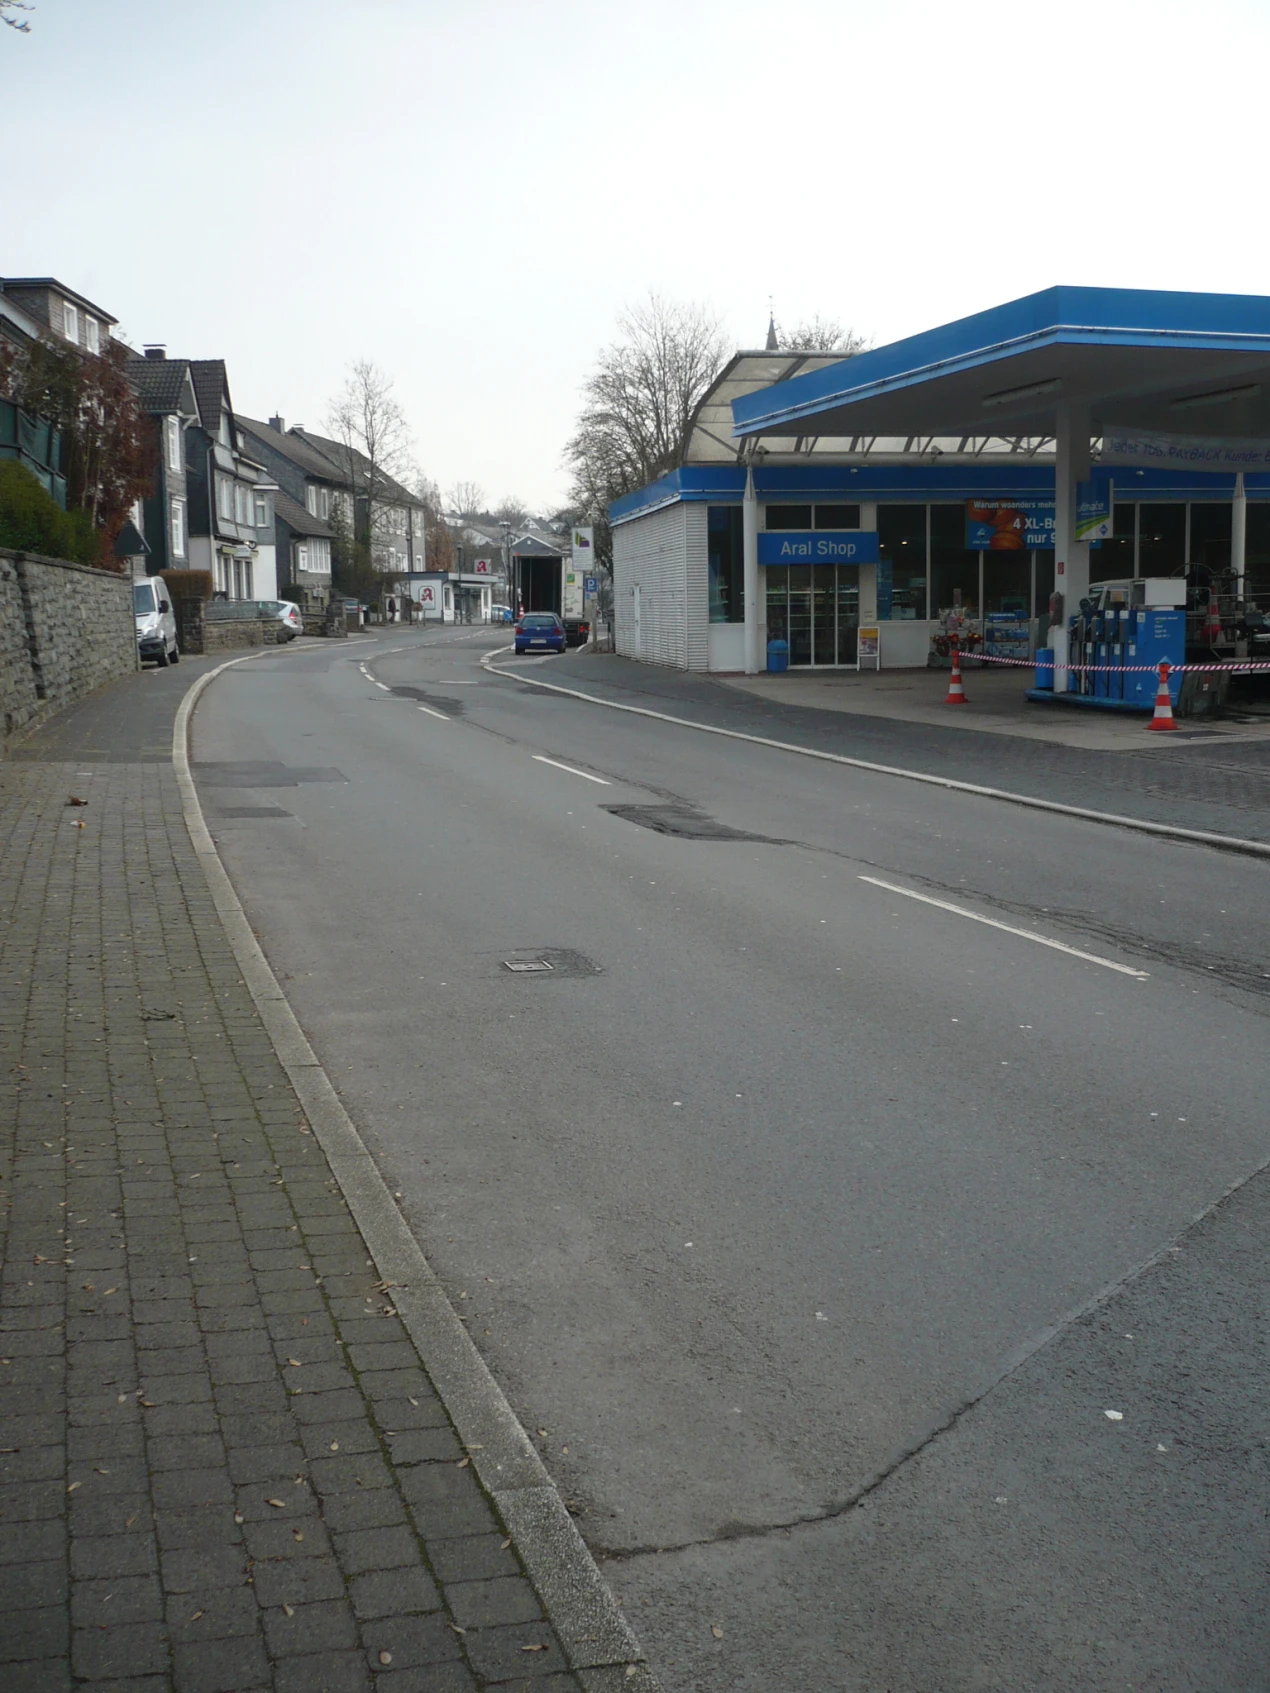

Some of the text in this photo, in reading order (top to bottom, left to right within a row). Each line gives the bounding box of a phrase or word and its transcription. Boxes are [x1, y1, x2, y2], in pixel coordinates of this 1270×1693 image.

[1169, 446, 1221, 461] PAYBACK
[973, 501, 999, 509] Warum
[1000, 501, 1036, 509] woanders
[1013, 518, 1021, 529] 4
[1027, 534, 1047, 544] nur
[780, 540, 857, 558] Aral Shop
[587, 579, 595, 591] P
